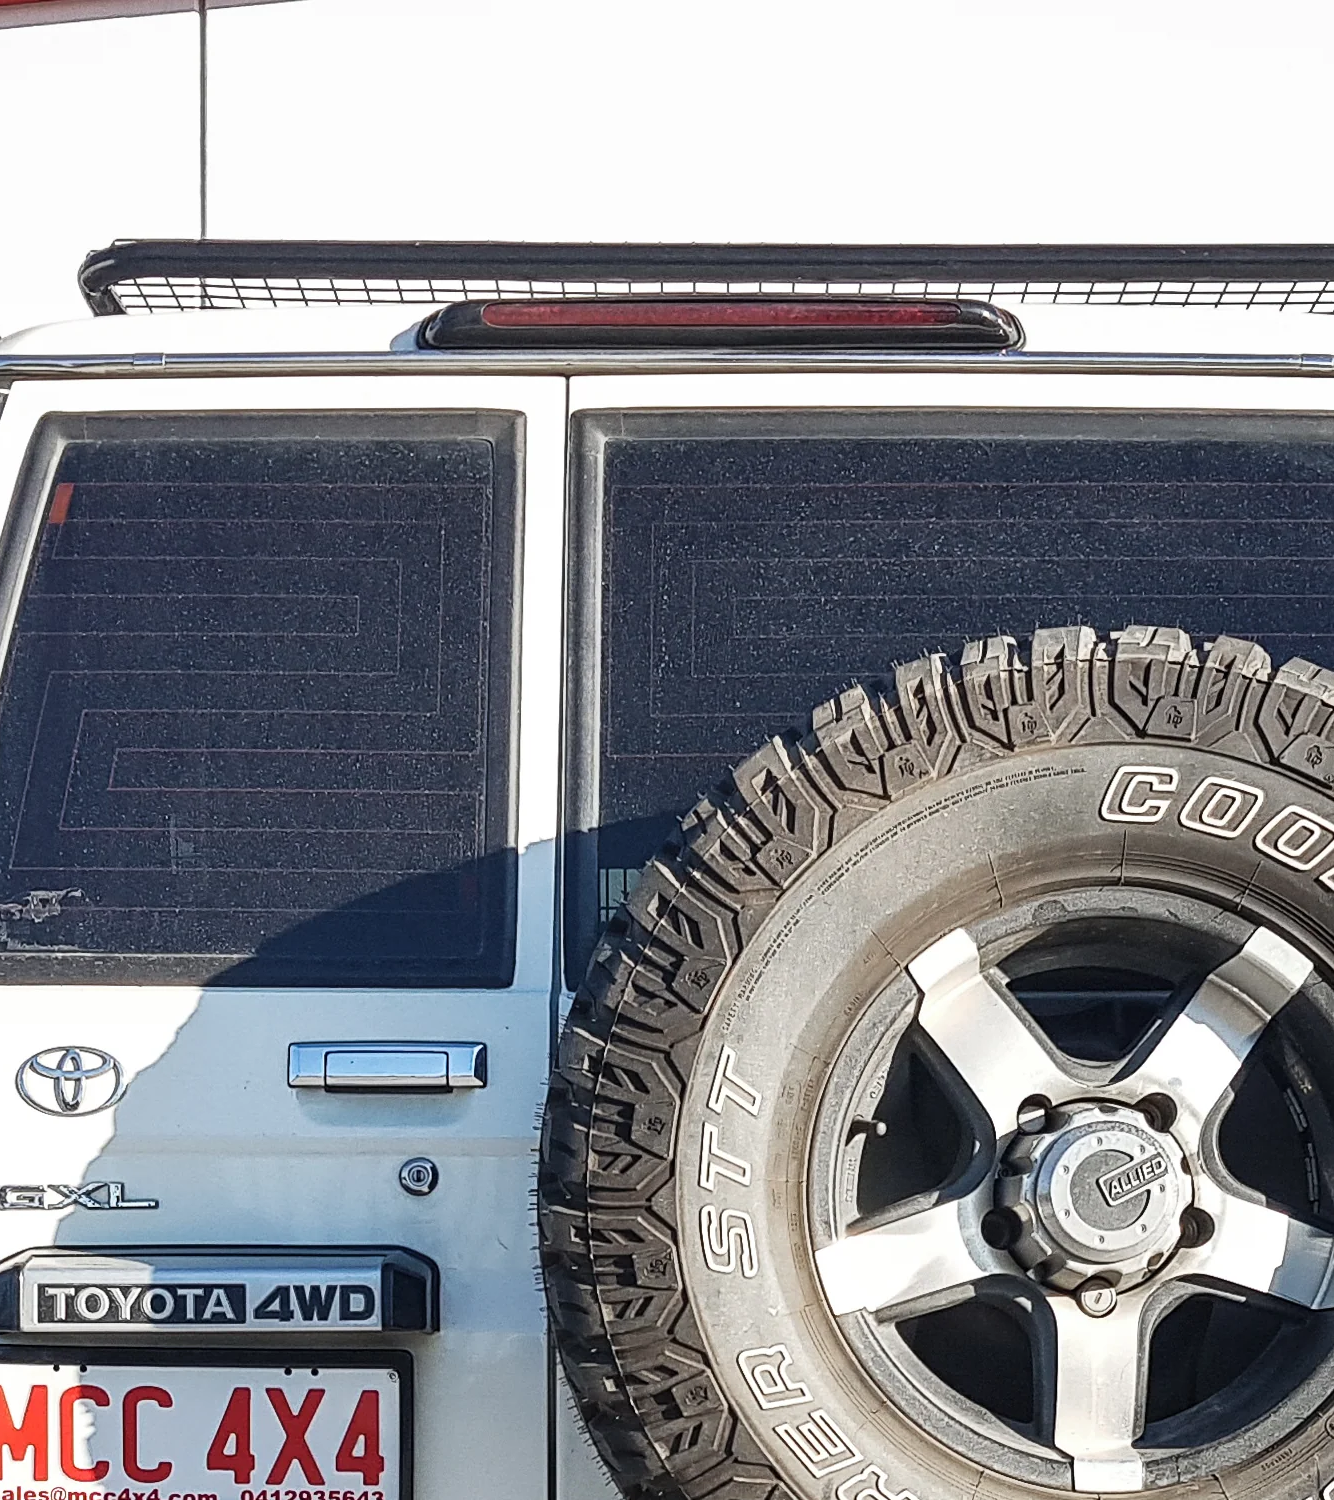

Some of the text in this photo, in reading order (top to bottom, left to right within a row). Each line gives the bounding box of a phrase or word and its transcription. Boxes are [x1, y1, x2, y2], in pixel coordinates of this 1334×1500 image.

[701, 1046, 761, 1278] STT
[1108, 1157, 1167, 1198] ALLIED
[43, 1284, 376, 1323] TOYOTA 4WD
[205, 1387, 385, 1487] 4X4
